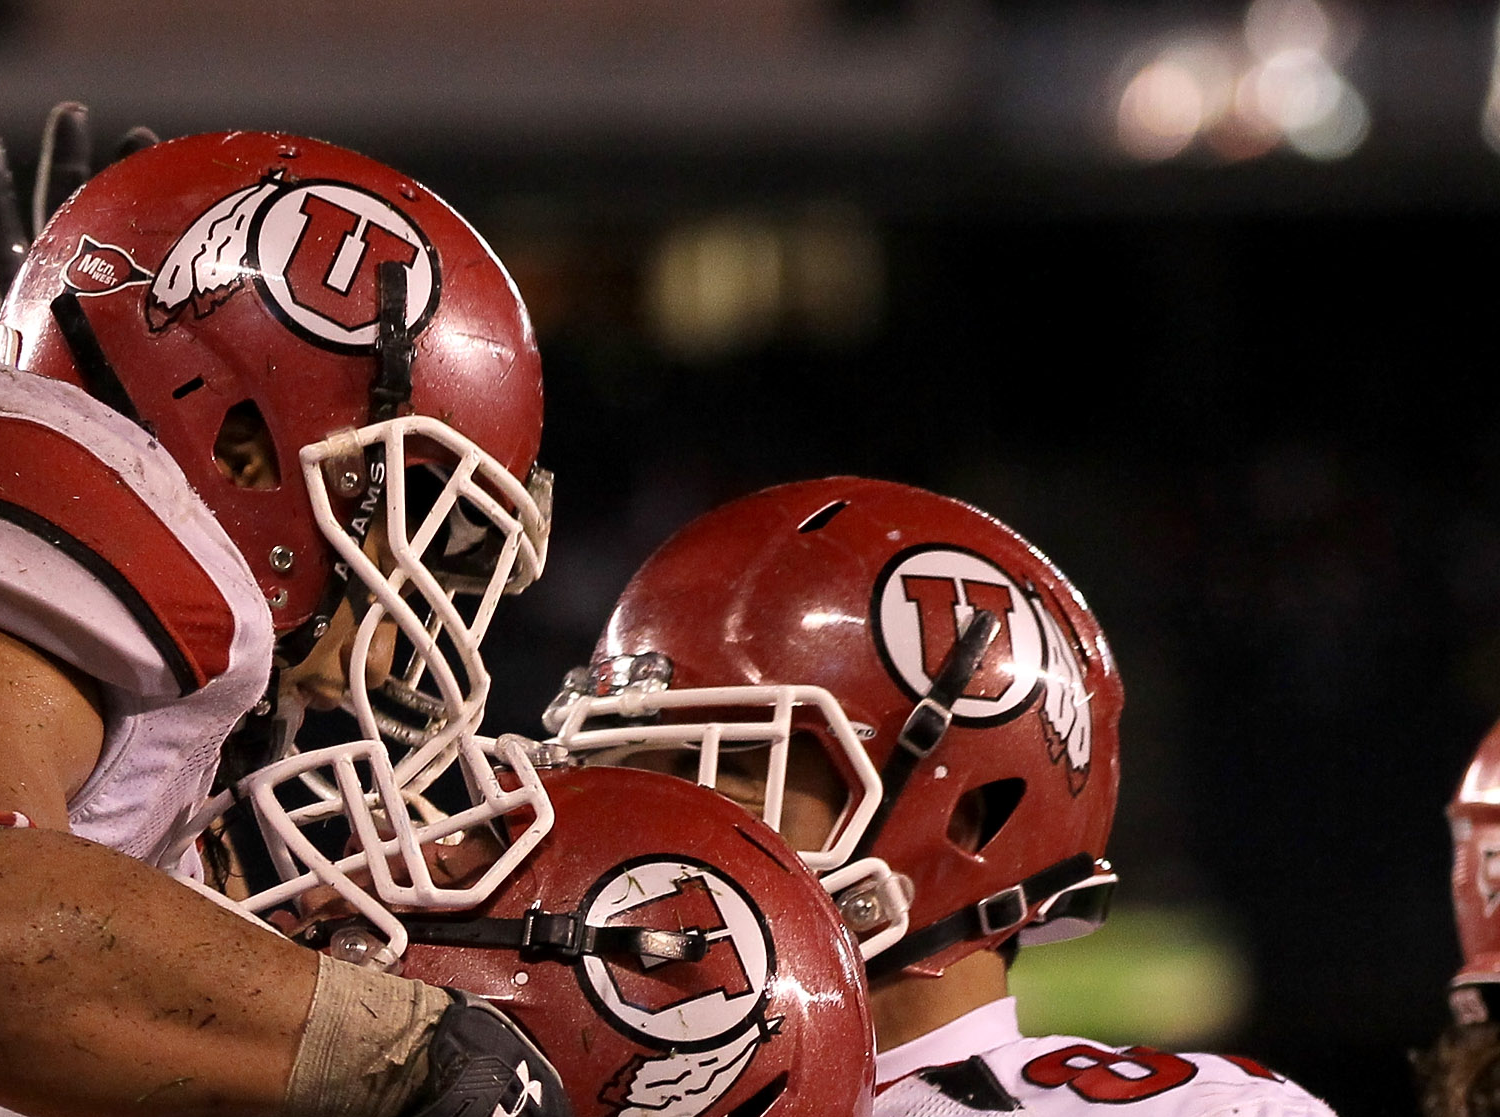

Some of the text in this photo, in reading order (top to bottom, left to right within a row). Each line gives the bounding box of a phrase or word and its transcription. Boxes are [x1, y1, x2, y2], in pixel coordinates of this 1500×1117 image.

[91, 271, 119, 287] WEST
[283, 191, 418, 332] U
[900, 574, 1016, 702] U
